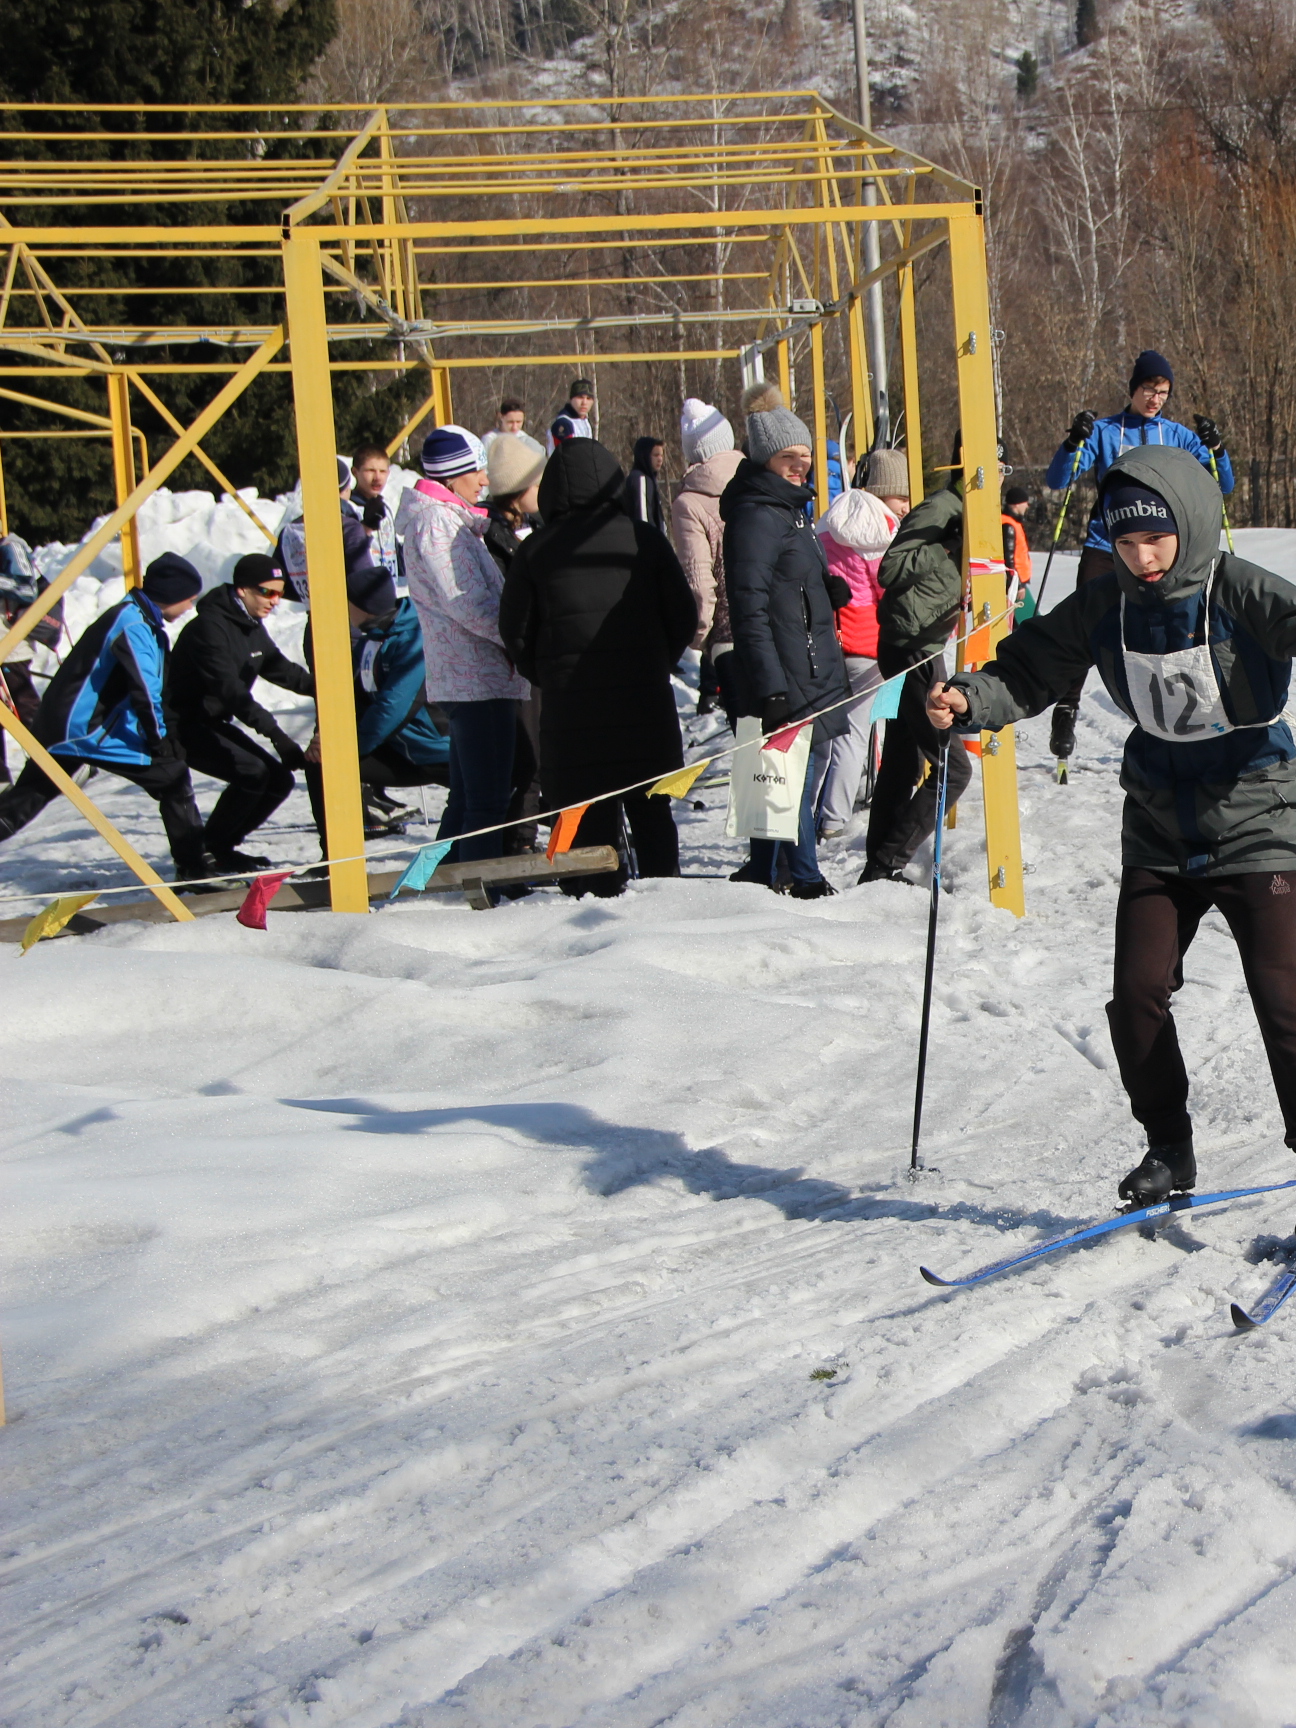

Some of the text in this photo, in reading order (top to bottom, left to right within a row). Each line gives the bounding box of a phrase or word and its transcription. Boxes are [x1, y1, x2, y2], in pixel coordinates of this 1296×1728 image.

[1106, 500, 1167, 529] lumbia
[1149, 672, 1206, 735] 12
[1146, 1205, 1168, 1217] FISCHER
